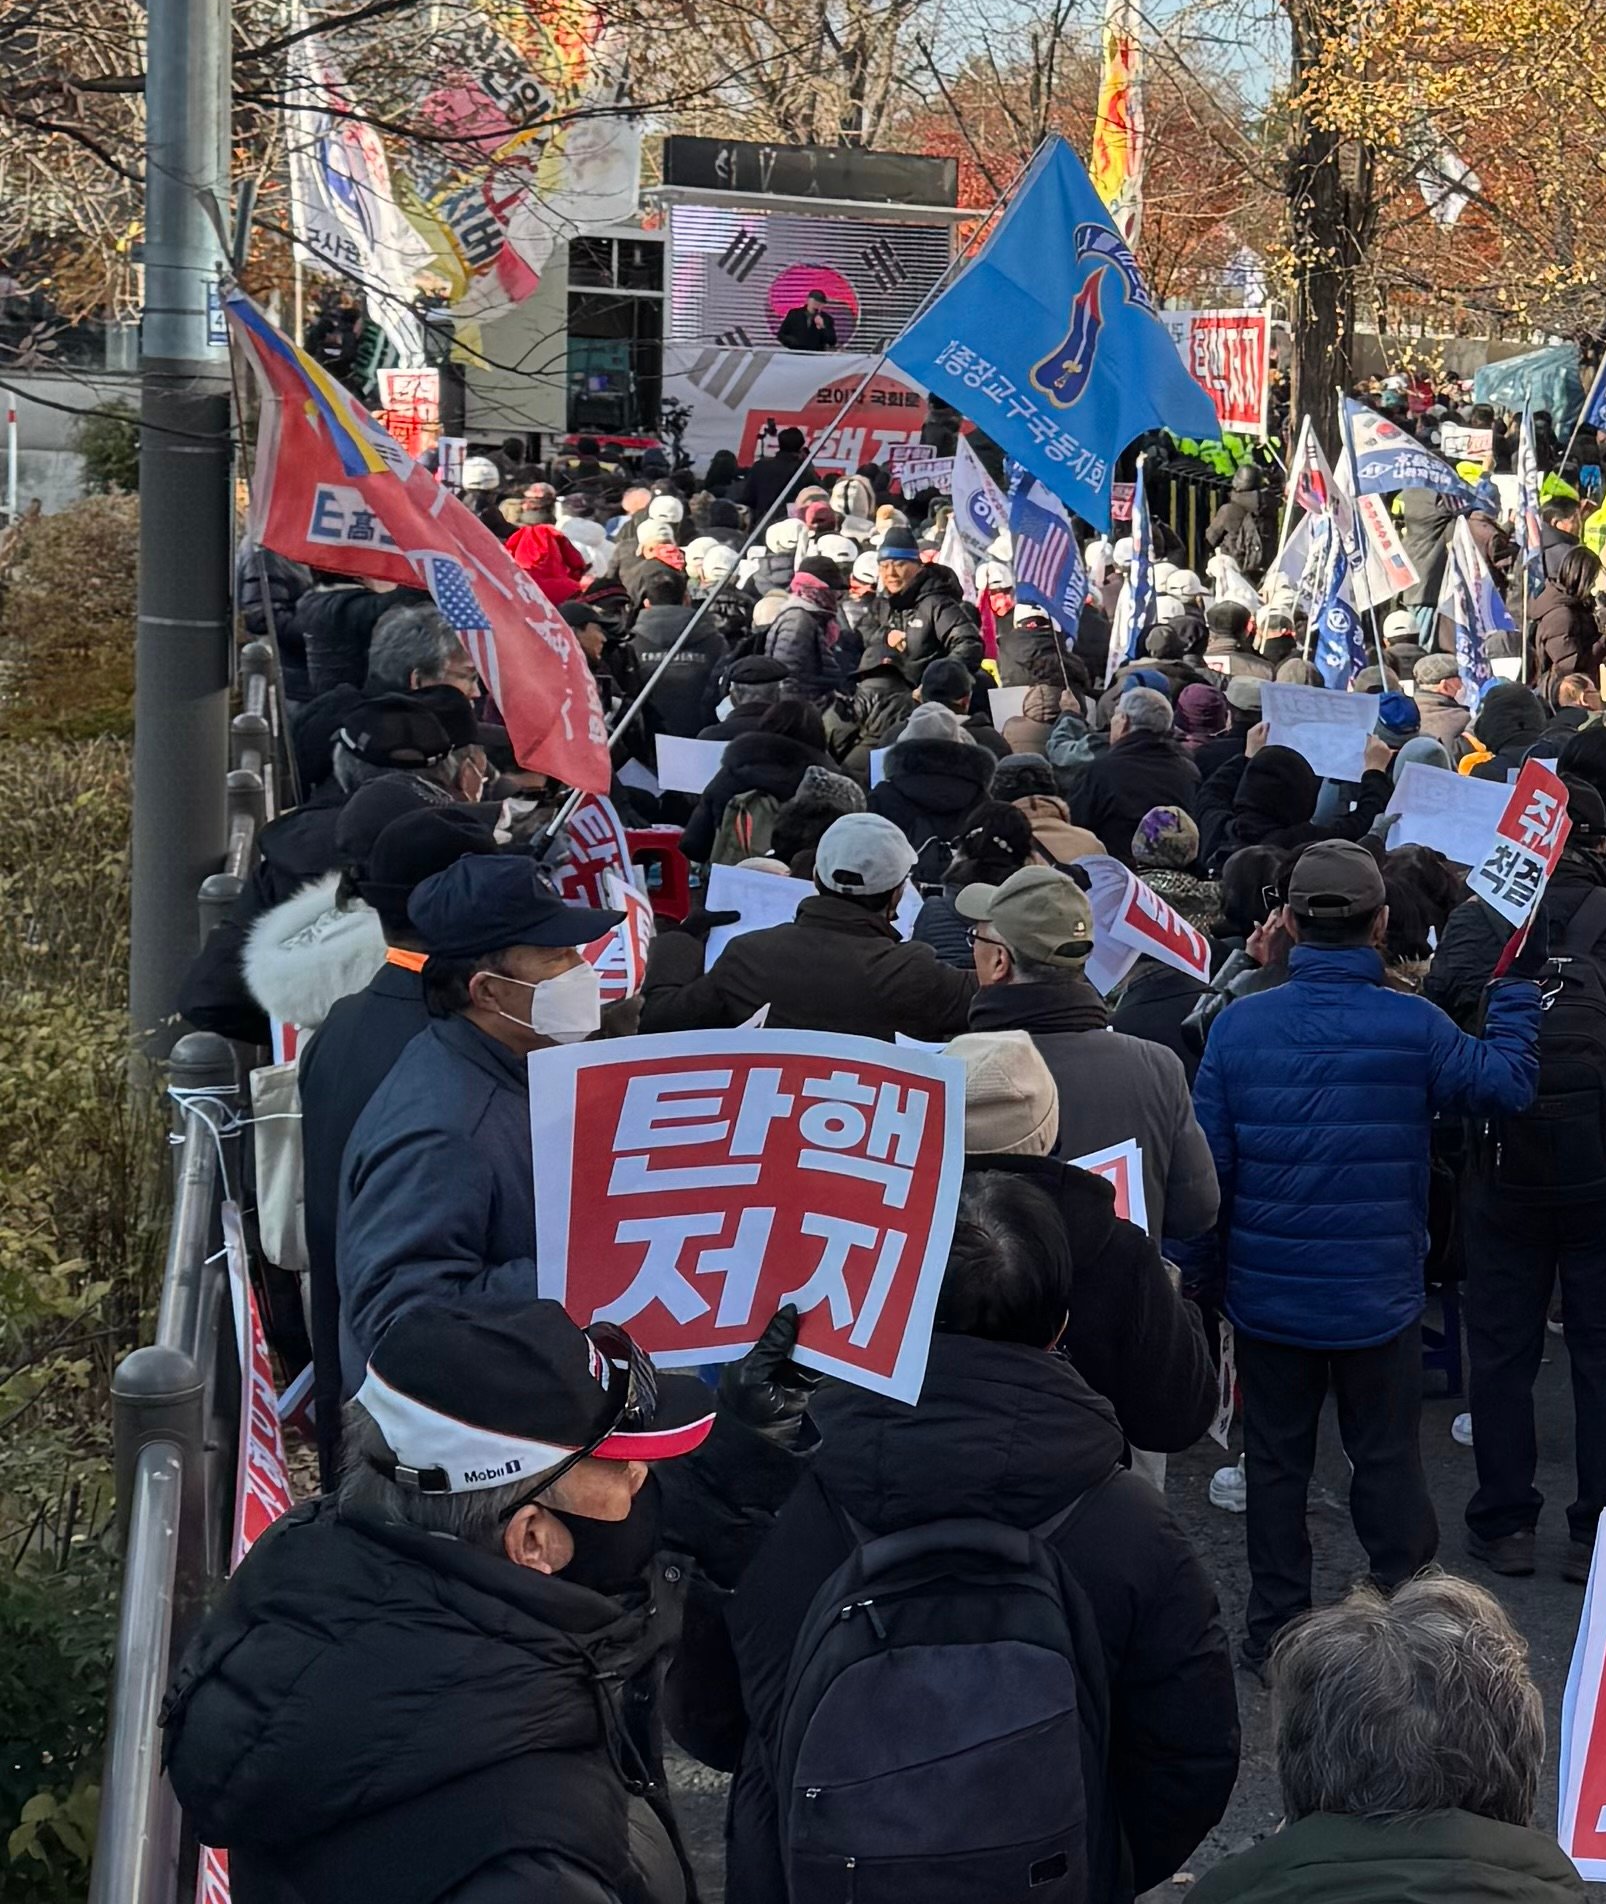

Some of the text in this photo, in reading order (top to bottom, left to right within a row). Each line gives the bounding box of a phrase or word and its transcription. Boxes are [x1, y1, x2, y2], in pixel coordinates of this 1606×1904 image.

[1480, 845, 1545, 909] 척결
[605, 1065, 931, 1210] 탄핵
[590, 1206, 909, 1350] 저지
